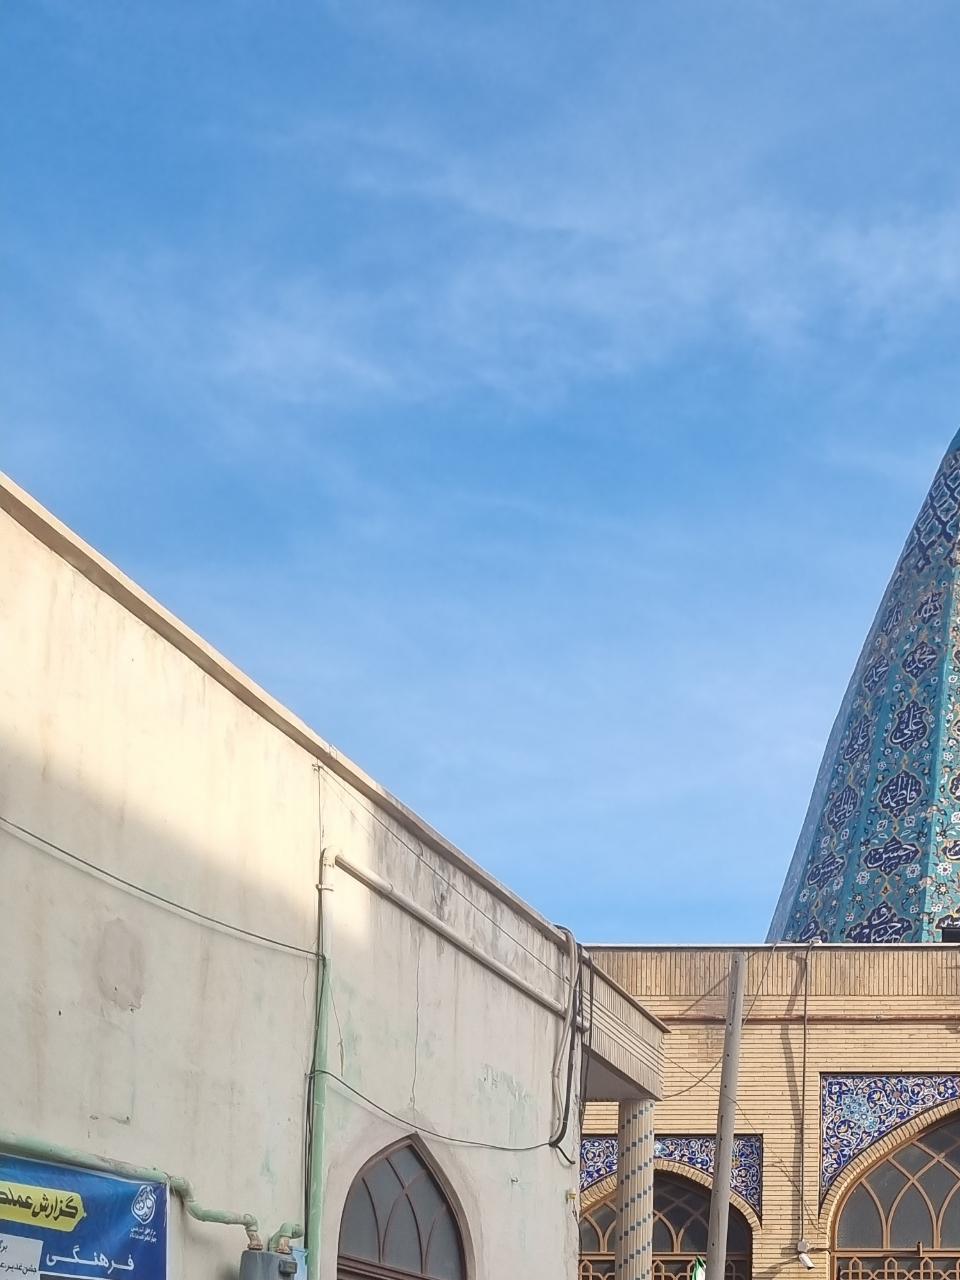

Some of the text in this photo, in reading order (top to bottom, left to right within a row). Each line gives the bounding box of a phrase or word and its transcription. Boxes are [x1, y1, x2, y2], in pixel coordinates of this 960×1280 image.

[31, 1193, 79, 1221] گزارش
[22, 1264, 37, 1275] جشن
[46, 1245, 134, 1274] فرهنگی
